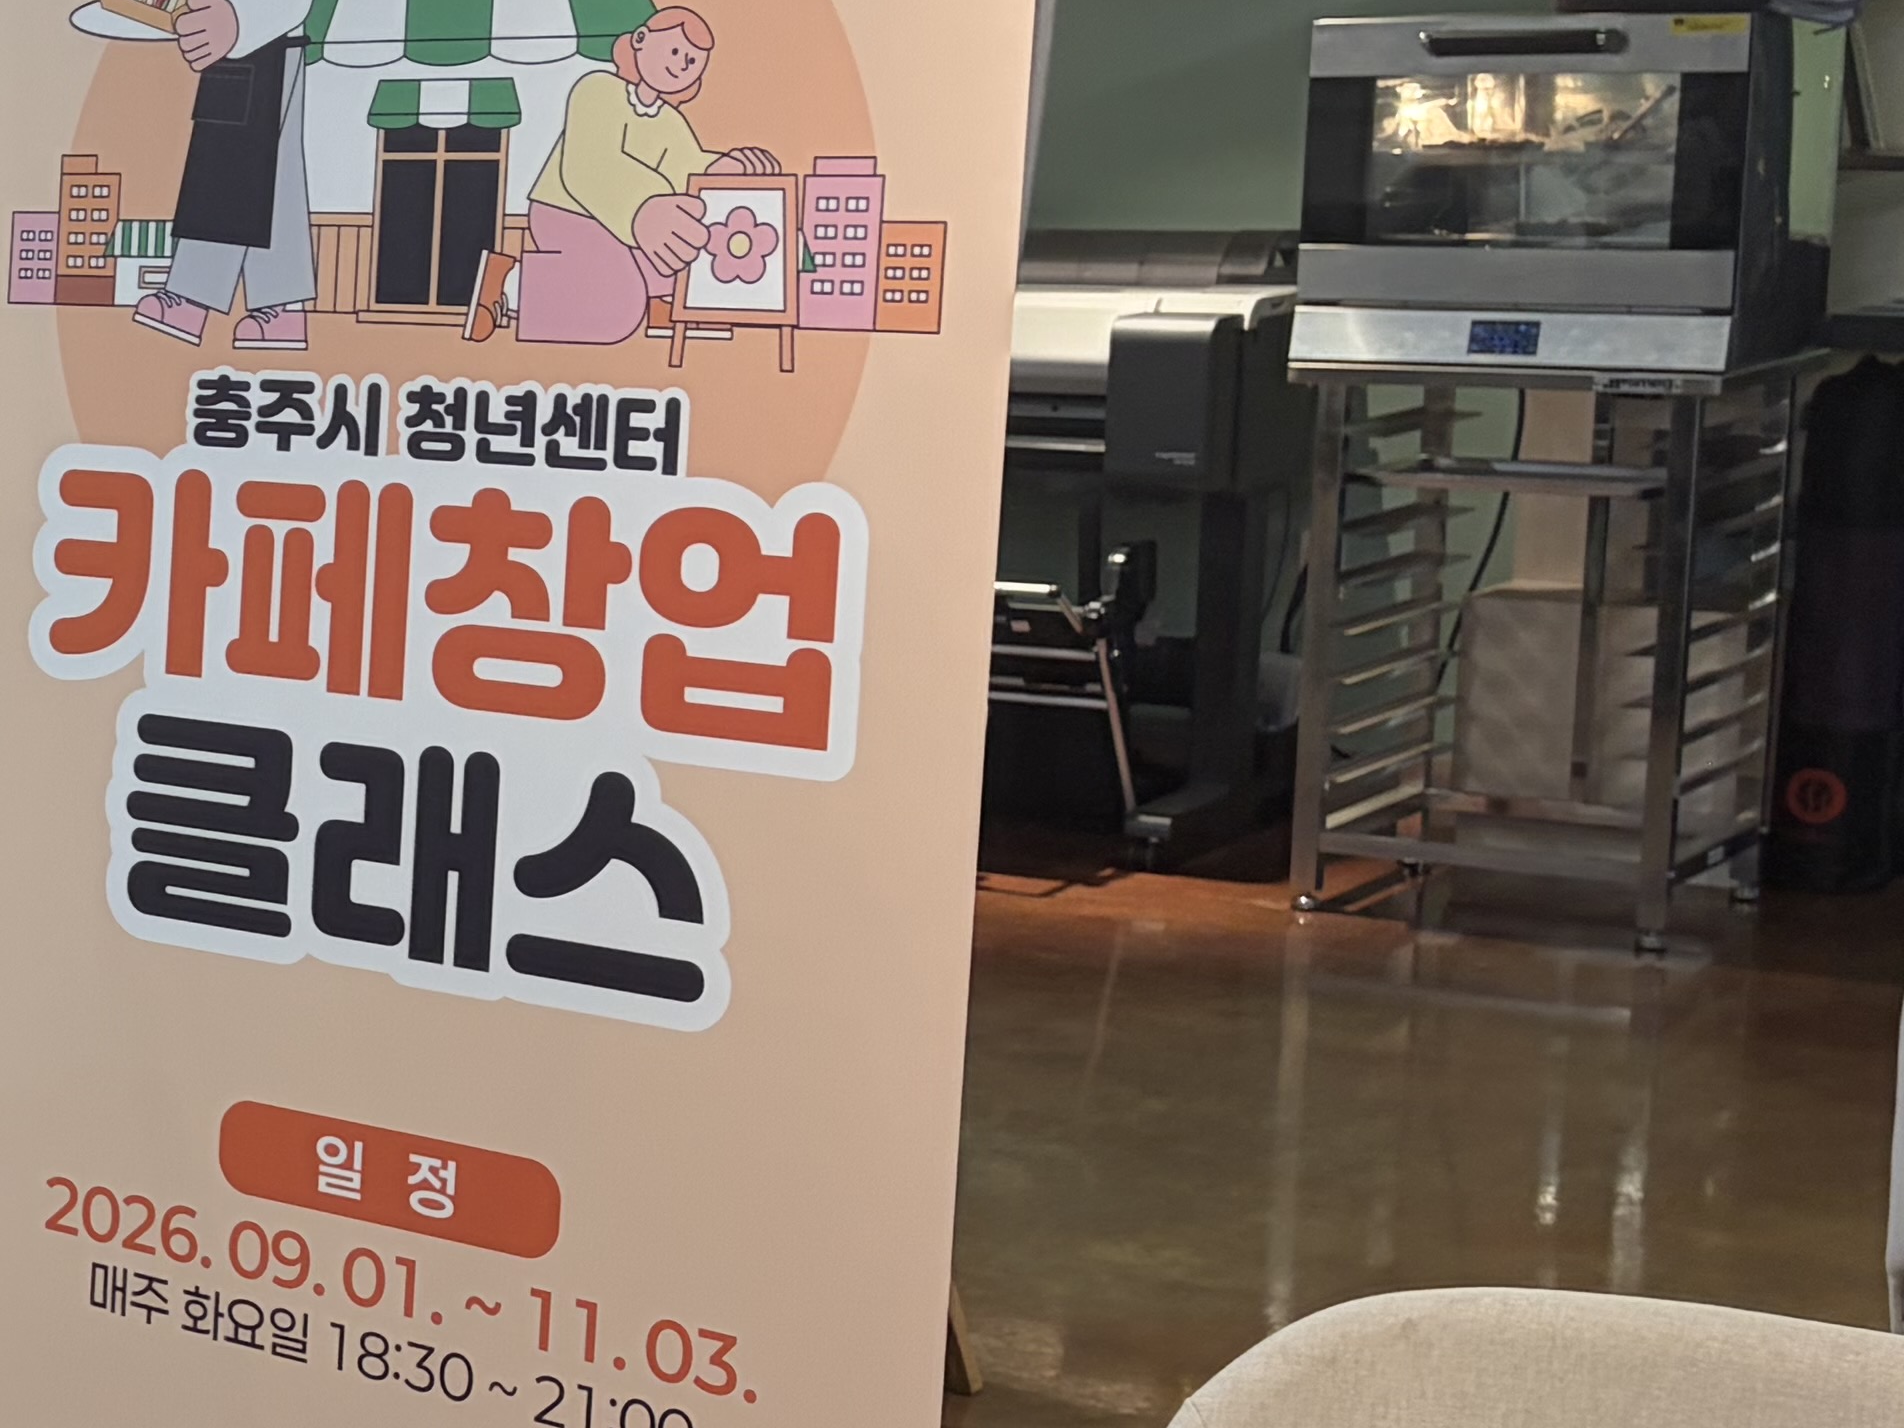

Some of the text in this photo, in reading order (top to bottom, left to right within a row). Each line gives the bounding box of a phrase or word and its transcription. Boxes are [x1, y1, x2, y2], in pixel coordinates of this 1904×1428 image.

[192, 373, 681, 476] 충주시 청년센터
[48, 467, 842, 752] 카페창업
[124, 713, 706, 1003] 클래스
[89, 1262, 170, 1325] 매주
[180, 1284, 309, 1364] 화요일
[329, 1321, 474, 1403] 18:30
